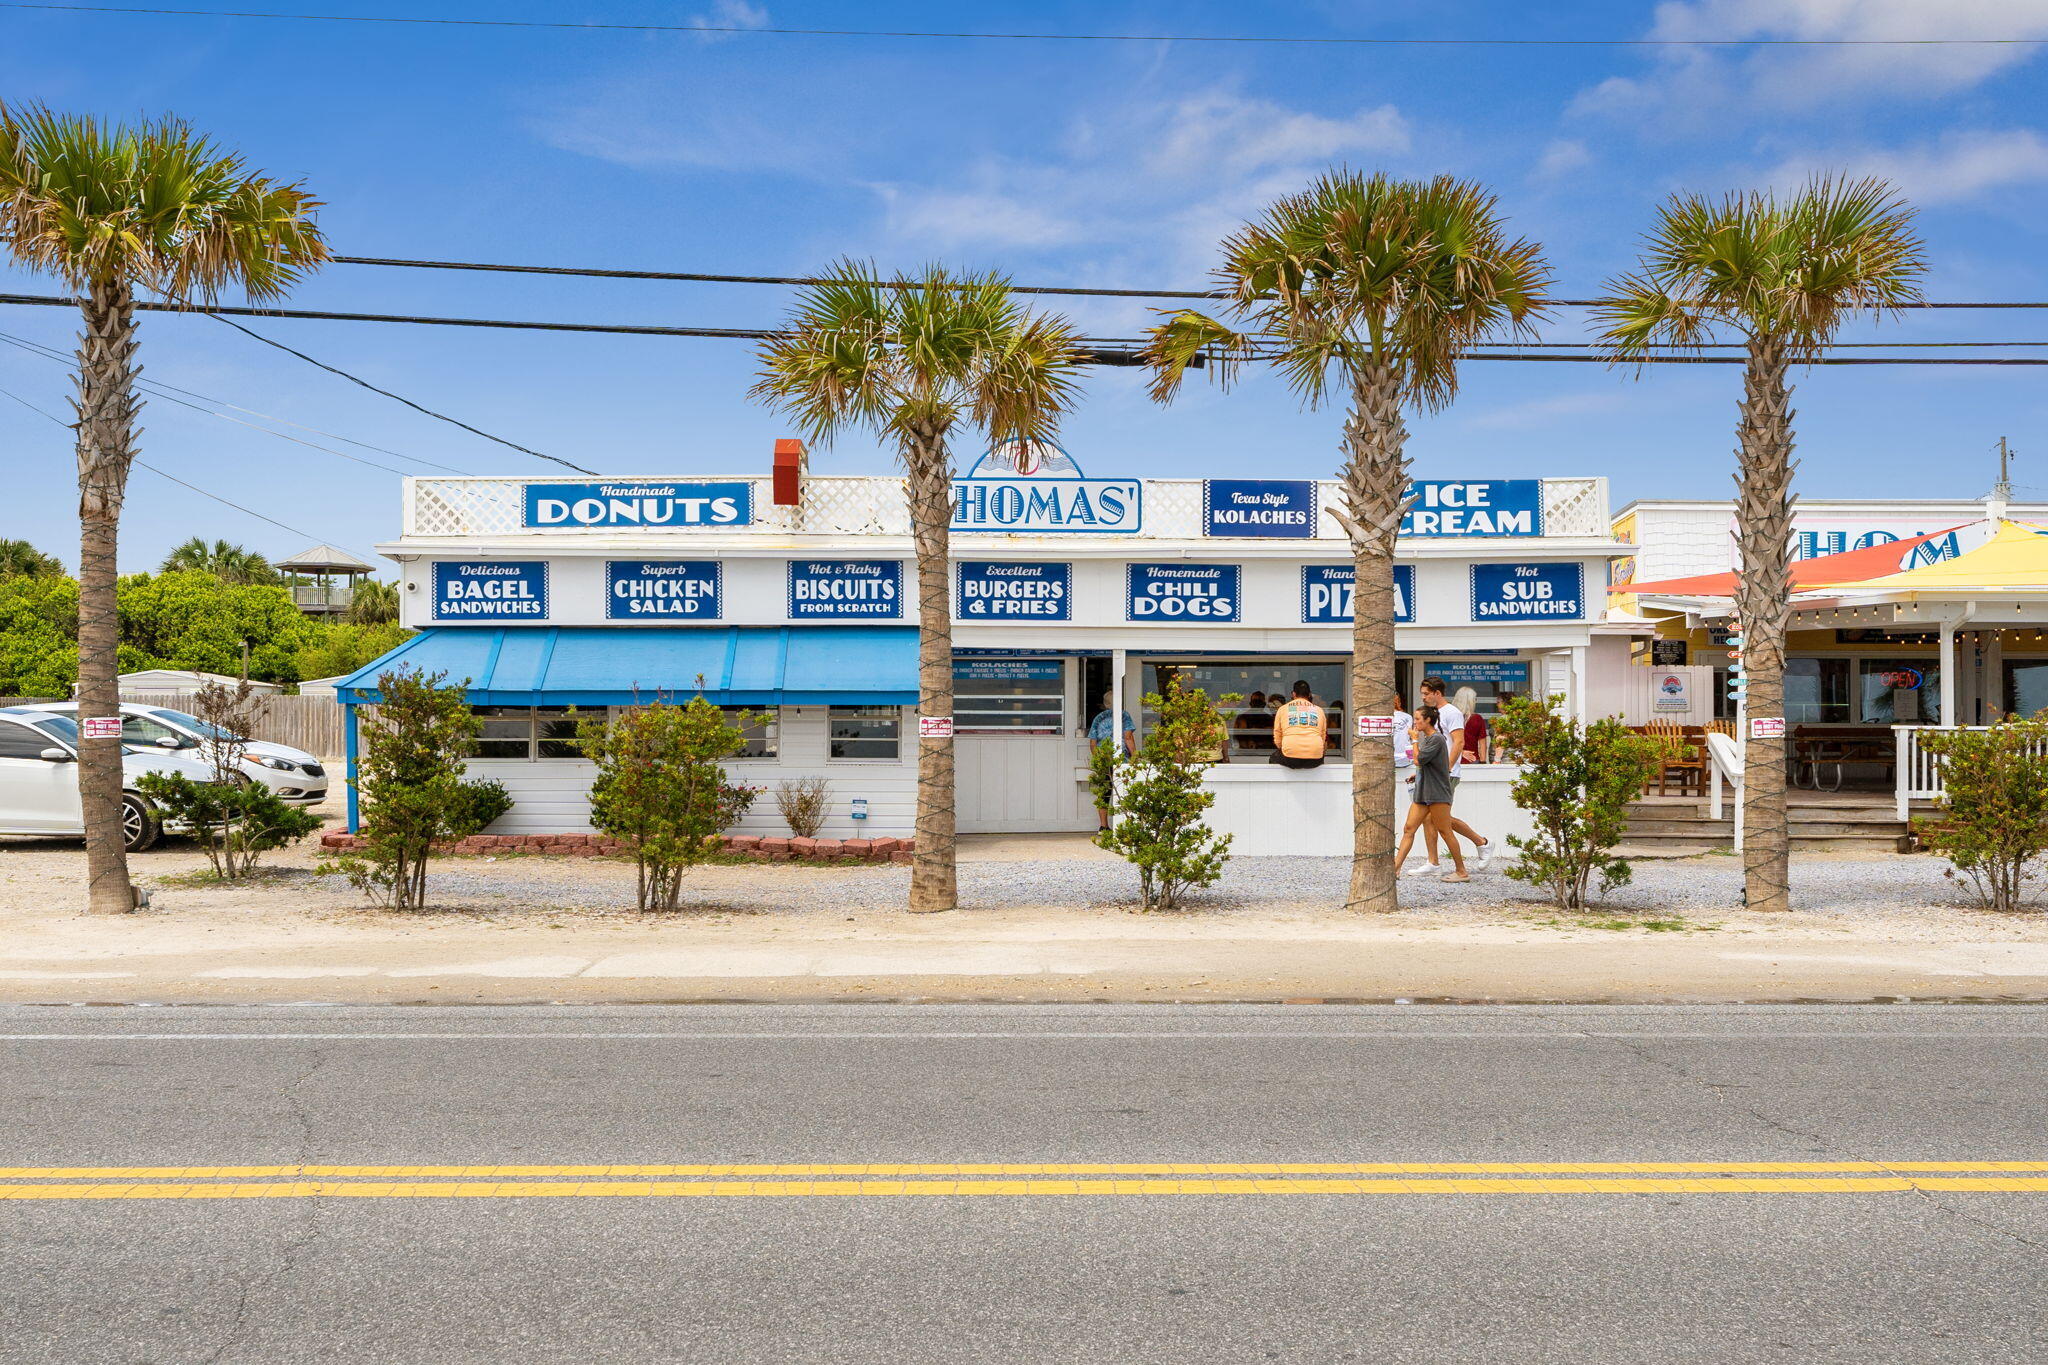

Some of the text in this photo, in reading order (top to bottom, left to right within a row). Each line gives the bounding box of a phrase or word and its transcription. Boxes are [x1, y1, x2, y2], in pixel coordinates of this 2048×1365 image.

[600, 485, 675, 497] Handmade
[1425, 484, 1491, 508] ICE
[951, 485, 1136, 525] HOMAS'
[1231, 492, 1290, 507] Texas Style
[537, 497, 739, 524] DONUTS
[1213, 510, 1307, 525] KOLACHES
[1398, 510, 1532, 534] CREAM
[459, 565, 521, 576] Delicious
[641, 564, 686, 577] Superb
[808, 564, 882, 577] Hot & Flaky
[986, 565, 1043, 576] Excellent
[1146, 567, 1221, 578] Homemade
[1514, 566, 1540, 577] Hot
[447, 580, 535, 599] BAGEL
[614, 580, 714, 598] CHICKEN
[796, 579, 896, 600] BISCUITS
[965, 581, 1064, 599] BURGERS
[1147, 582, 1218, 597] CHILI
[1502, 581, 1553, 600] SUB
[440, 600, 541, 614] SANDWICHES
[629, 599, 699, 613] SALAD
[800, 603, 891, 613] FROM SCRATCH
[969, 600, 1059, 614] & FRIES
[1134, 597, 1233, 617] DOGS
[1310, 584, 1408, 617] PIZA
[1479, 600, 1577, 615] SANDWICHES
[1881, 672, 1916, 687] OPEN
